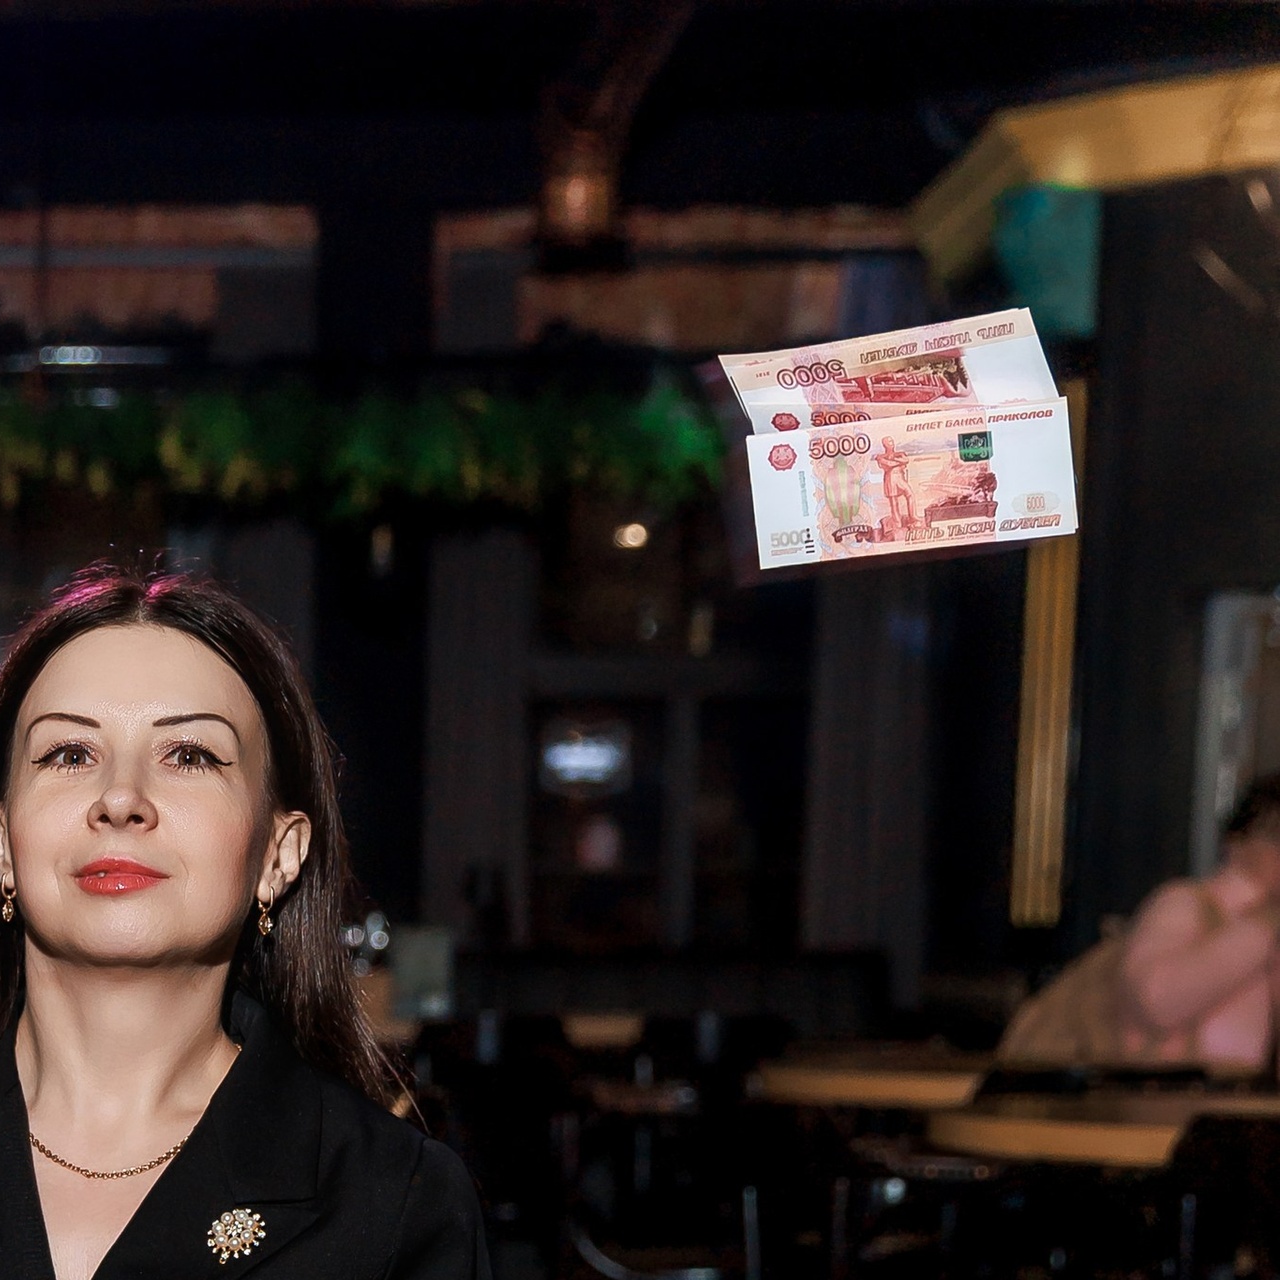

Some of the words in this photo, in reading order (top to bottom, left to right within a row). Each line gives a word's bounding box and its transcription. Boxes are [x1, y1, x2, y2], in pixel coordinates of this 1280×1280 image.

[776, 359, 849, 389] 5000
[906, 421, 942, 433] БИЛЕТ
[945, 416, 985, 429] БАНКА
[987, 409, 1054, 424] ПРИКОЛОВ
[809, 433, 871, 459] 5000
[905, 526, 945, 542] ПЯТЬ
[947, 520, 997, 537] ТЫСЯЧ
[999, 514, 1062, 532] ДУБЛЕЙ
